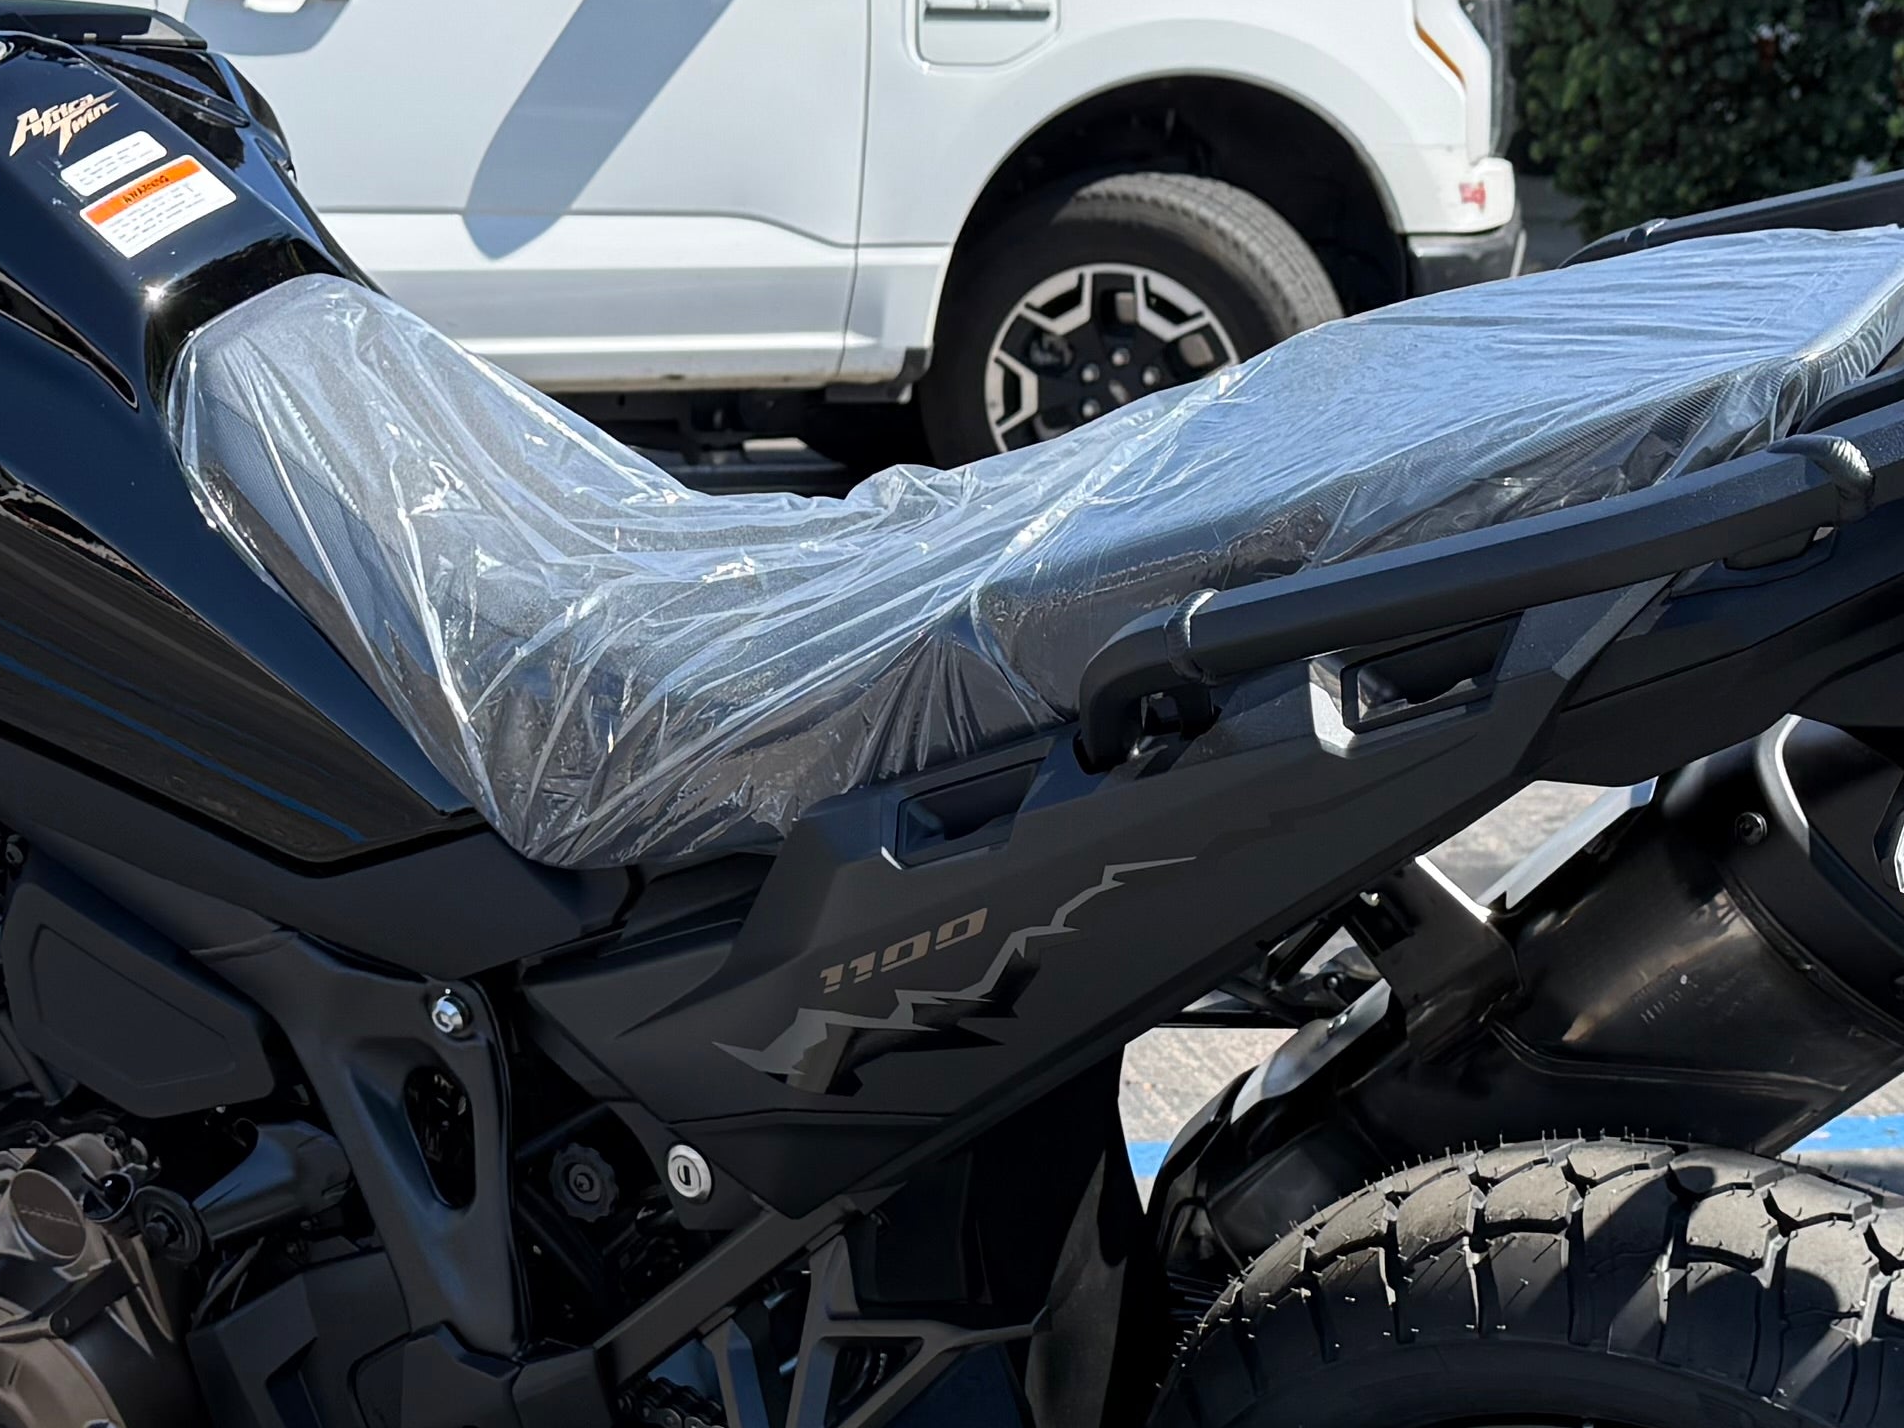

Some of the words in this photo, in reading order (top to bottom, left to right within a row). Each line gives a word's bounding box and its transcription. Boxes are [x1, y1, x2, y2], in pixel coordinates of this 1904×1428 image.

[9, 89, 118, 157] Africa
[58, 102, 119, 156] Twin
[819, 906, 989, 995] 1100
